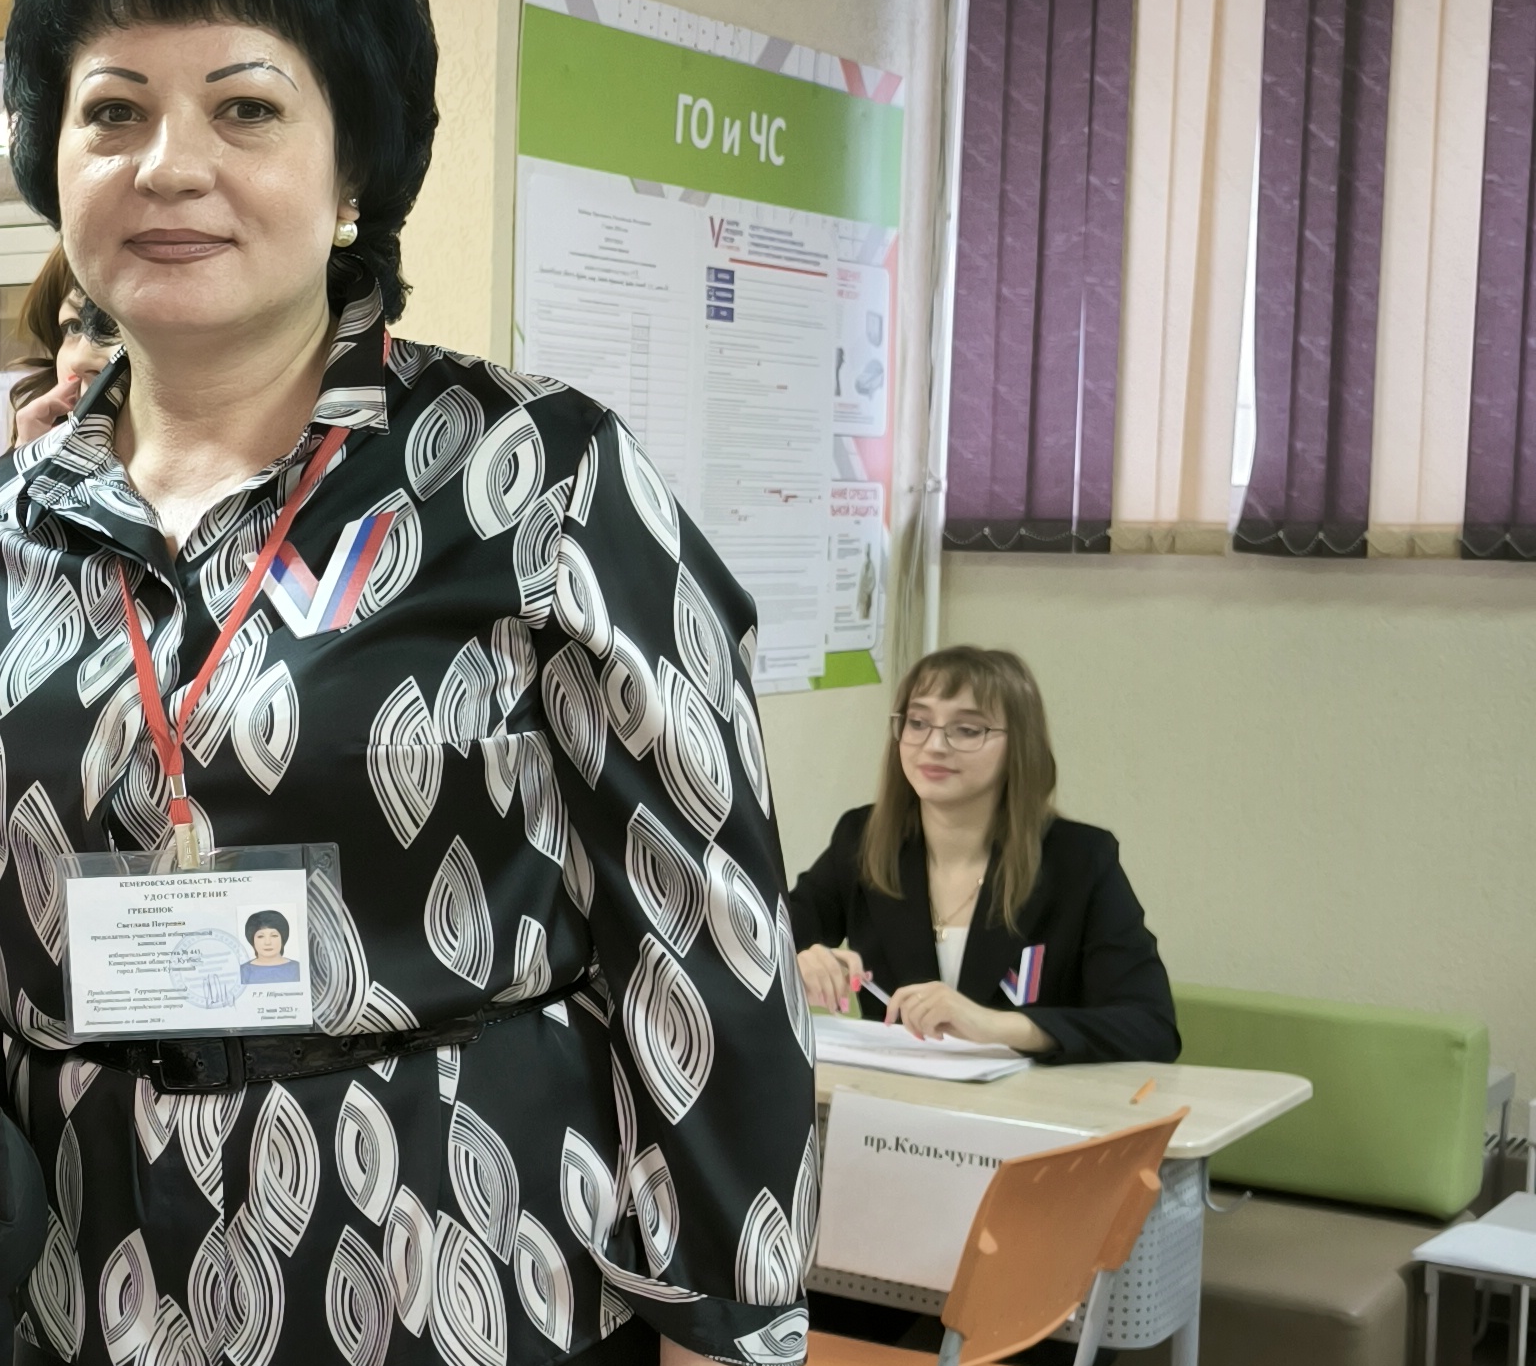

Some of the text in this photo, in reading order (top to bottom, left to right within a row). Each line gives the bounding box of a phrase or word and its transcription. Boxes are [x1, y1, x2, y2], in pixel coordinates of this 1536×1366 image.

[675, 93, 786, 166] ГО и ЧС
[119, 879, 175, 888] КЕМЕРОВСКАЯ
[176, 877, 212, 886] ОБЛАСТЬ
[218, 876, 253, 884] КУЗБАСС
[143, 890, 228, 901] УДОСТОВЕРЕНИЕ
